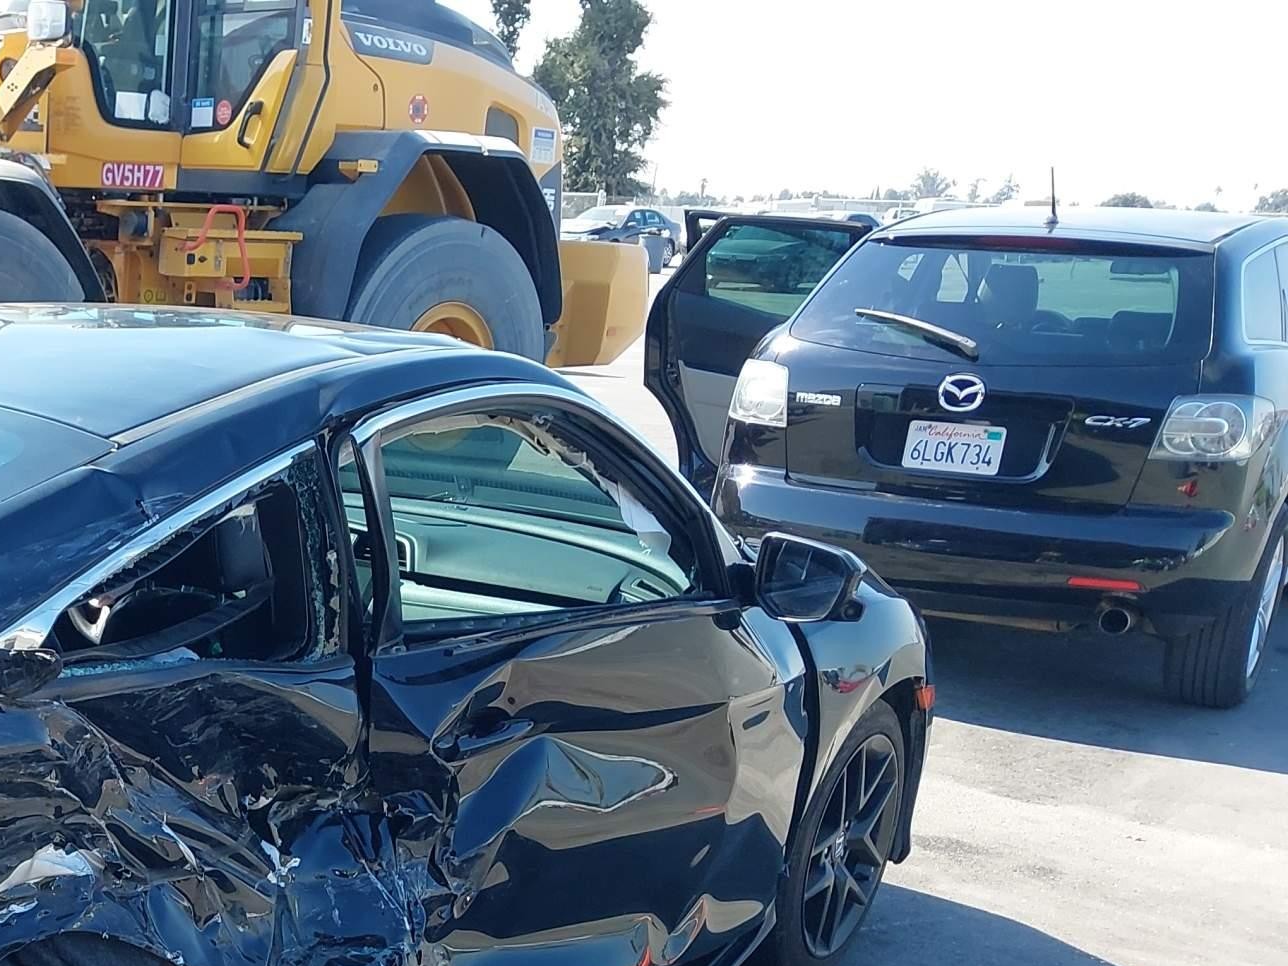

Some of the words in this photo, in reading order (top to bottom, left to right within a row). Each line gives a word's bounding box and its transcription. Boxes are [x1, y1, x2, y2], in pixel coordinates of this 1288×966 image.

[354, 31, 427, 56] VOLVO
[102, 162, 164, 188] GV5H77
[927, 424, 986, 441] California
[1085, 415, 1152, 429] CX-7
[910, 439, 993, 467] 6LGK734
